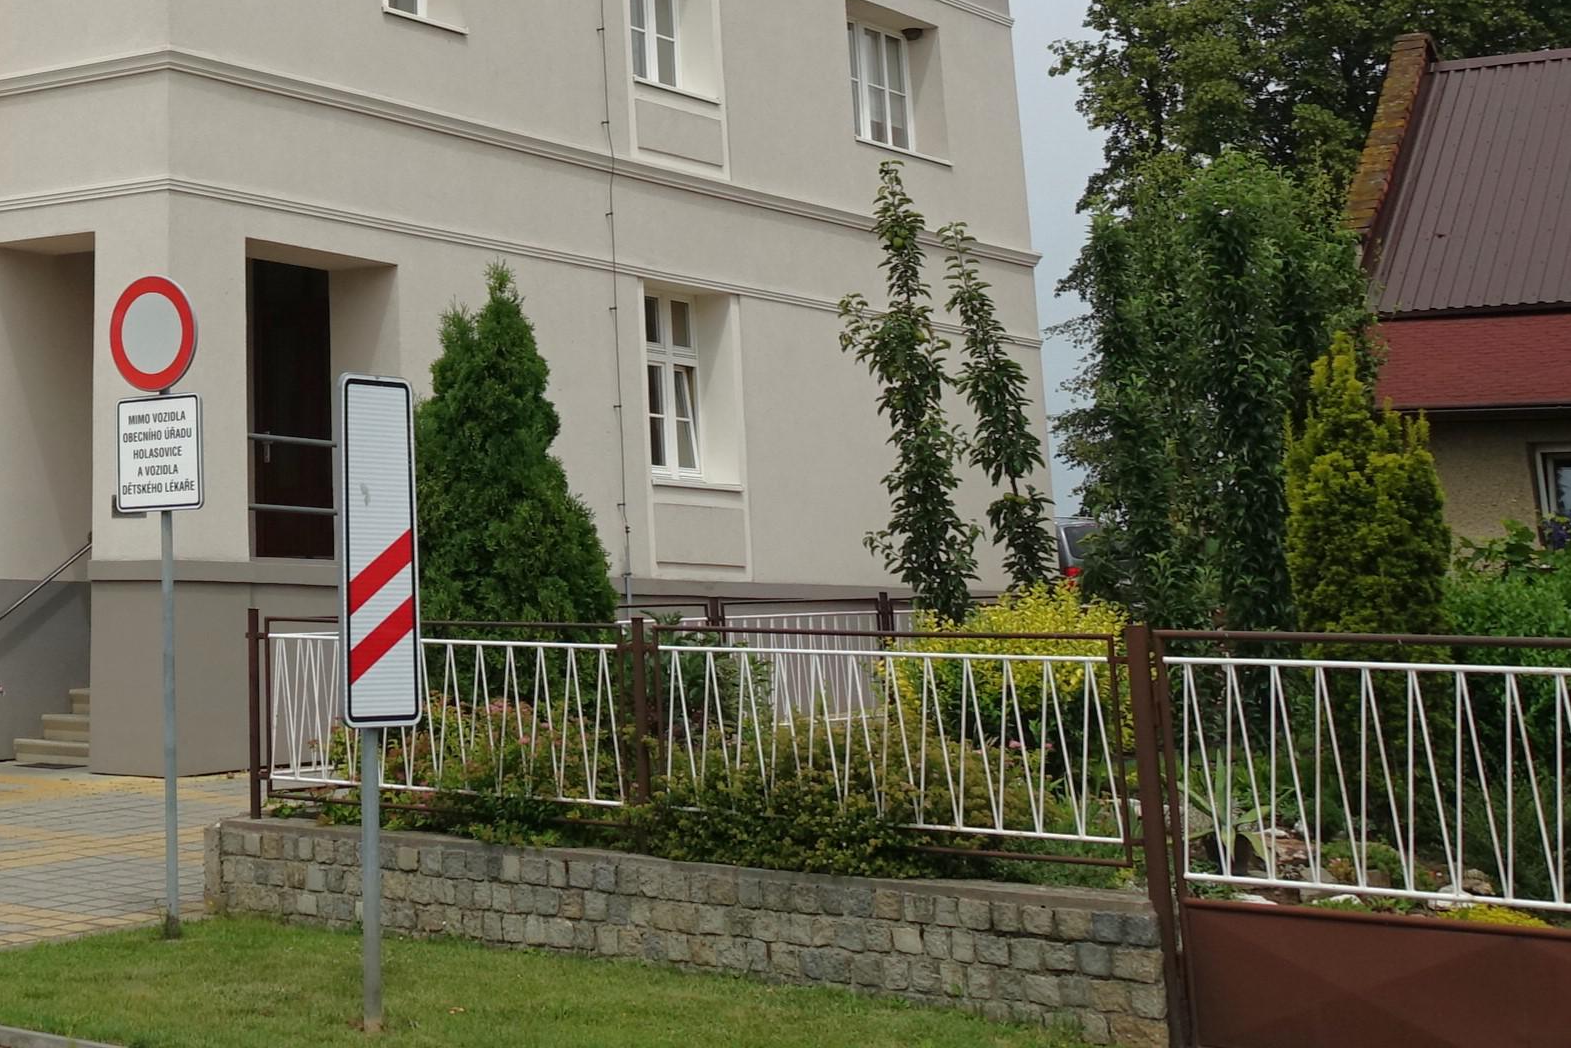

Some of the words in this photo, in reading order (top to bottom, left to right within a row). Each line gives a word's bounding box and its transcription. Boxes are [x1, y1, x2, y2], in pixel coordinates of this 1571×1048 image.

[128, 413, 150, 424] MIMO
[152, 411, 186, 423] VOZIDLA
[123, 428, 162, 442] OBECNÍHO
[164, 427, 192, 439] ÚŘADU
[133, 446, 182, 459] HOLASOVICE
[138, 466, 143, 476] A
[145, 464, 178, 476] VOZIDLA
[165, 479, 195, 492] LÉKAŘE
